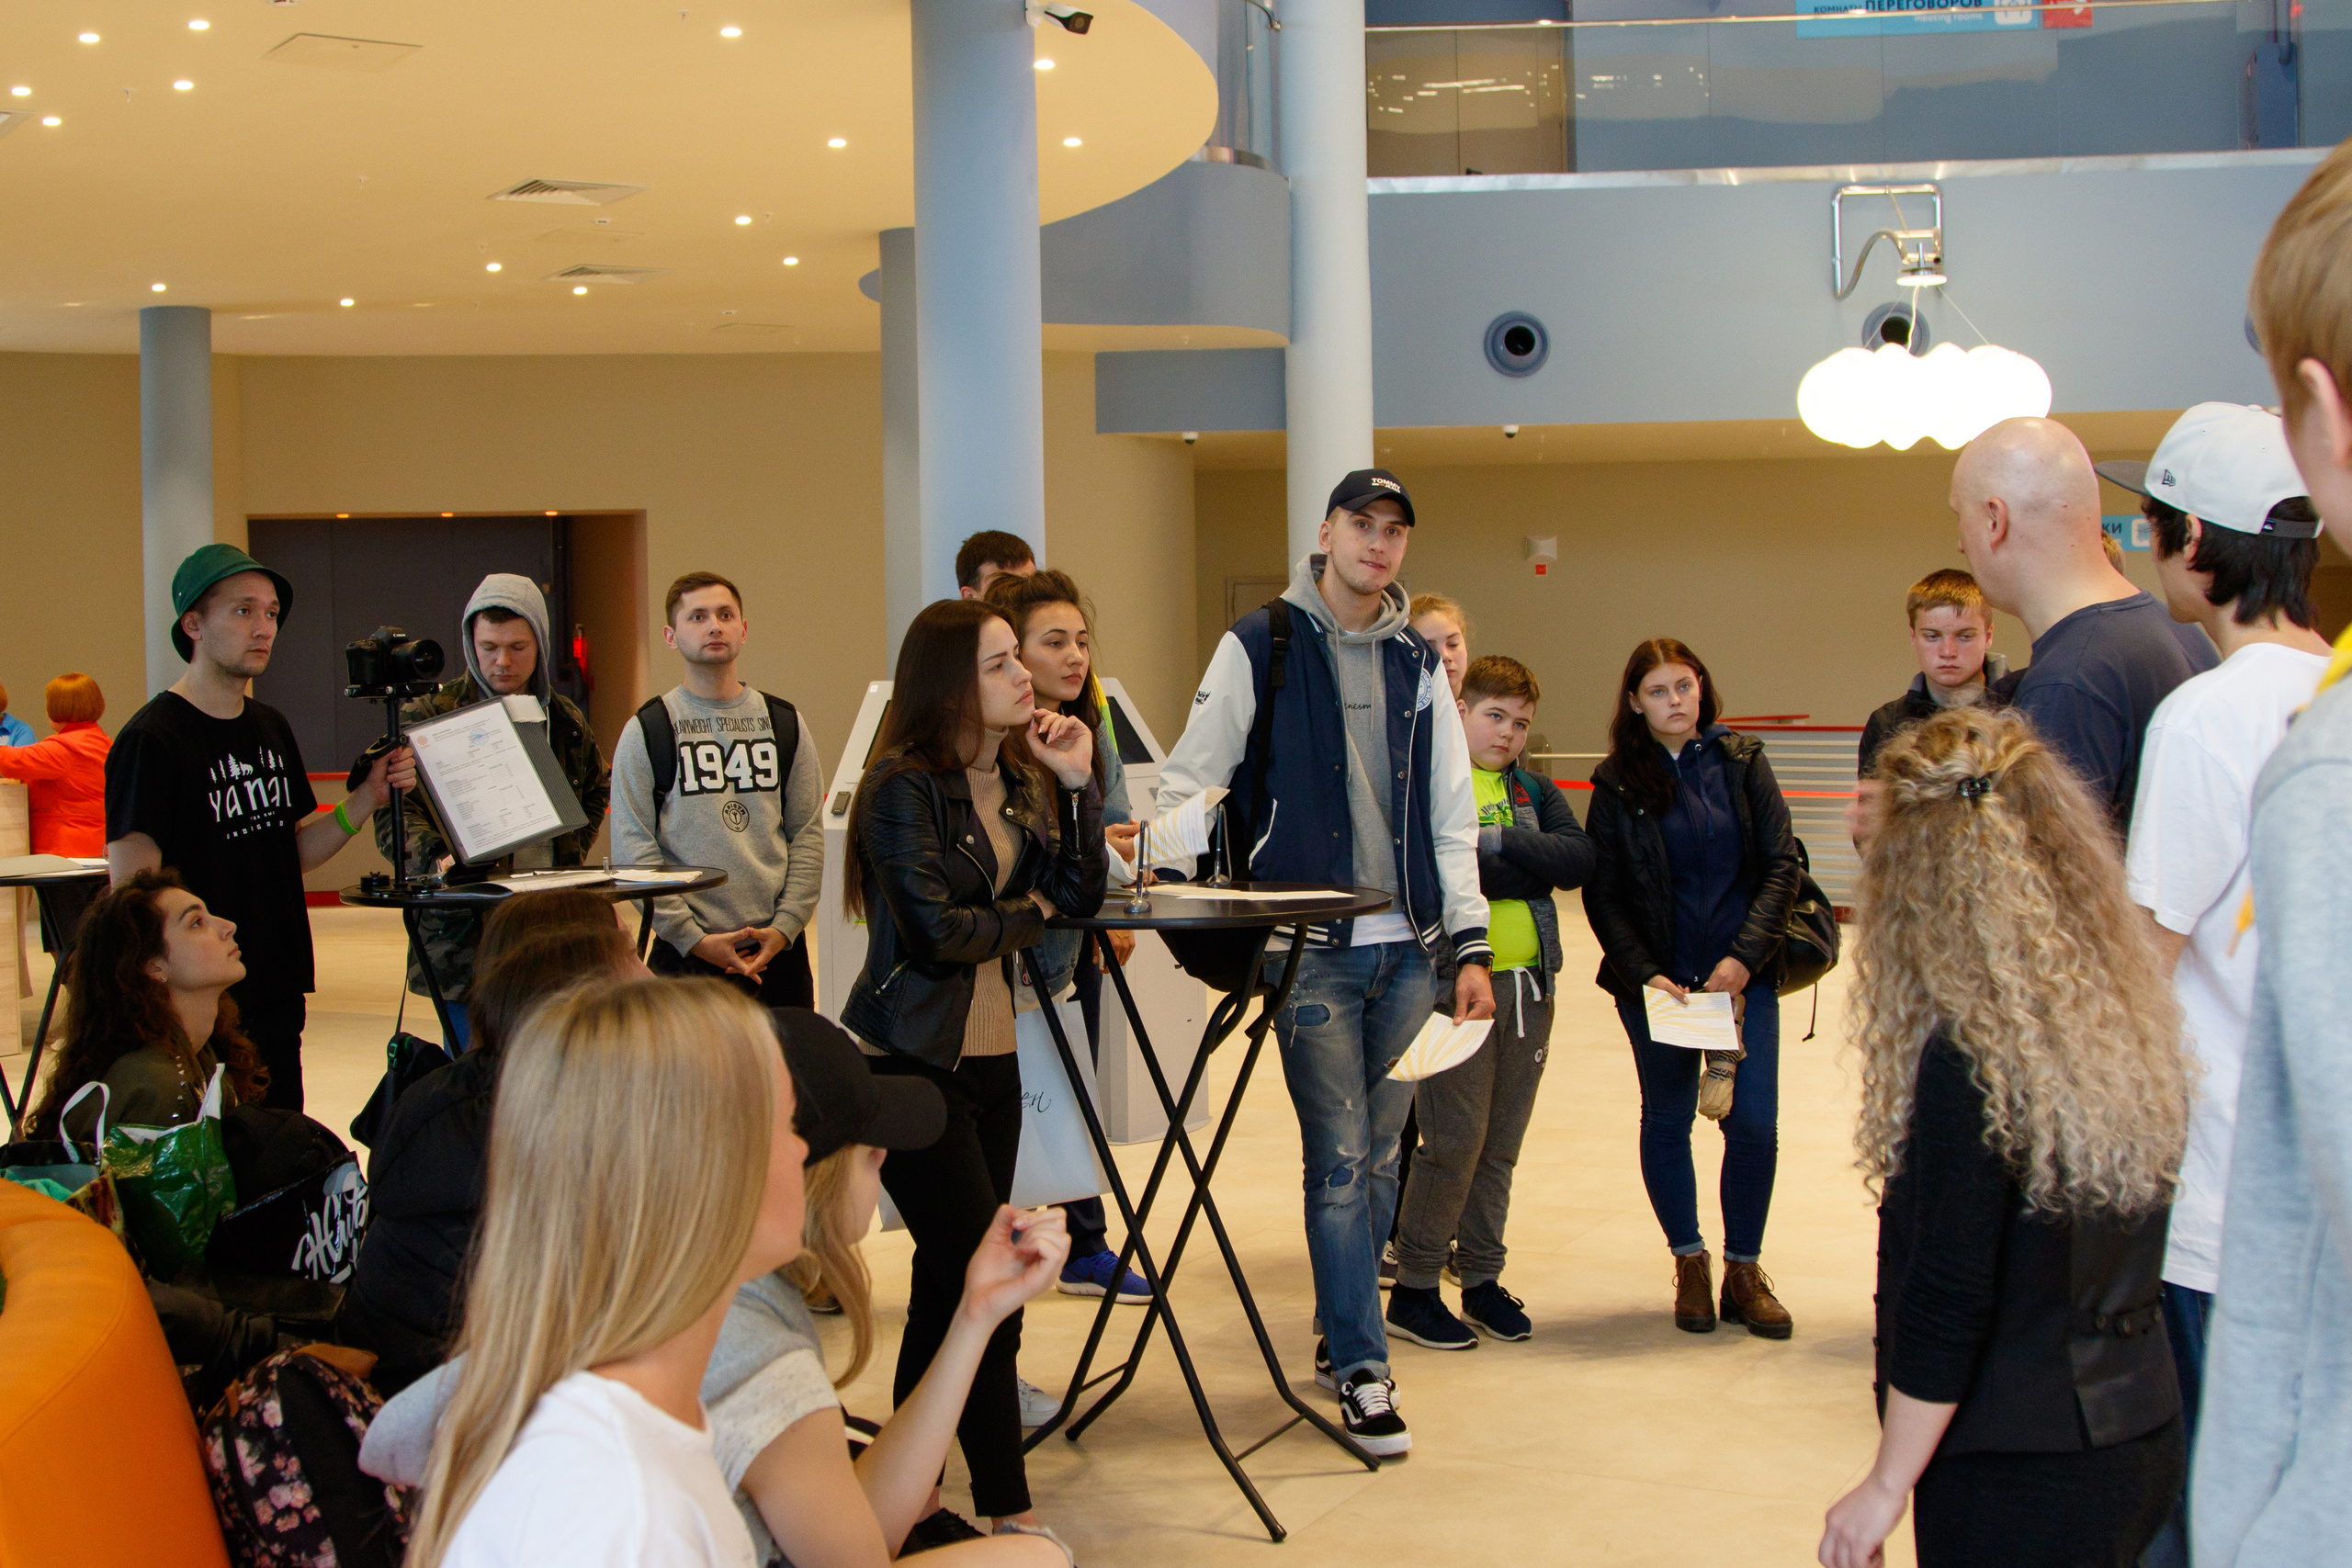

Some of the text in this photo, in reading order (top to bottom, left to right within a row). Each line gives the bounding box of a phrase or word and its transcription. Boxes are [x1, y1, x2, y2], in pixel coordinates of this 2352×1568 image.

[1866, 0, 1982, 11] ПЕРЕГОВОРОВ
[1371, 478, 1401, 491] TOMMY
[717, 717, 755, 732] SPECIALISTS
[679, 739, 779, 795] 1949
